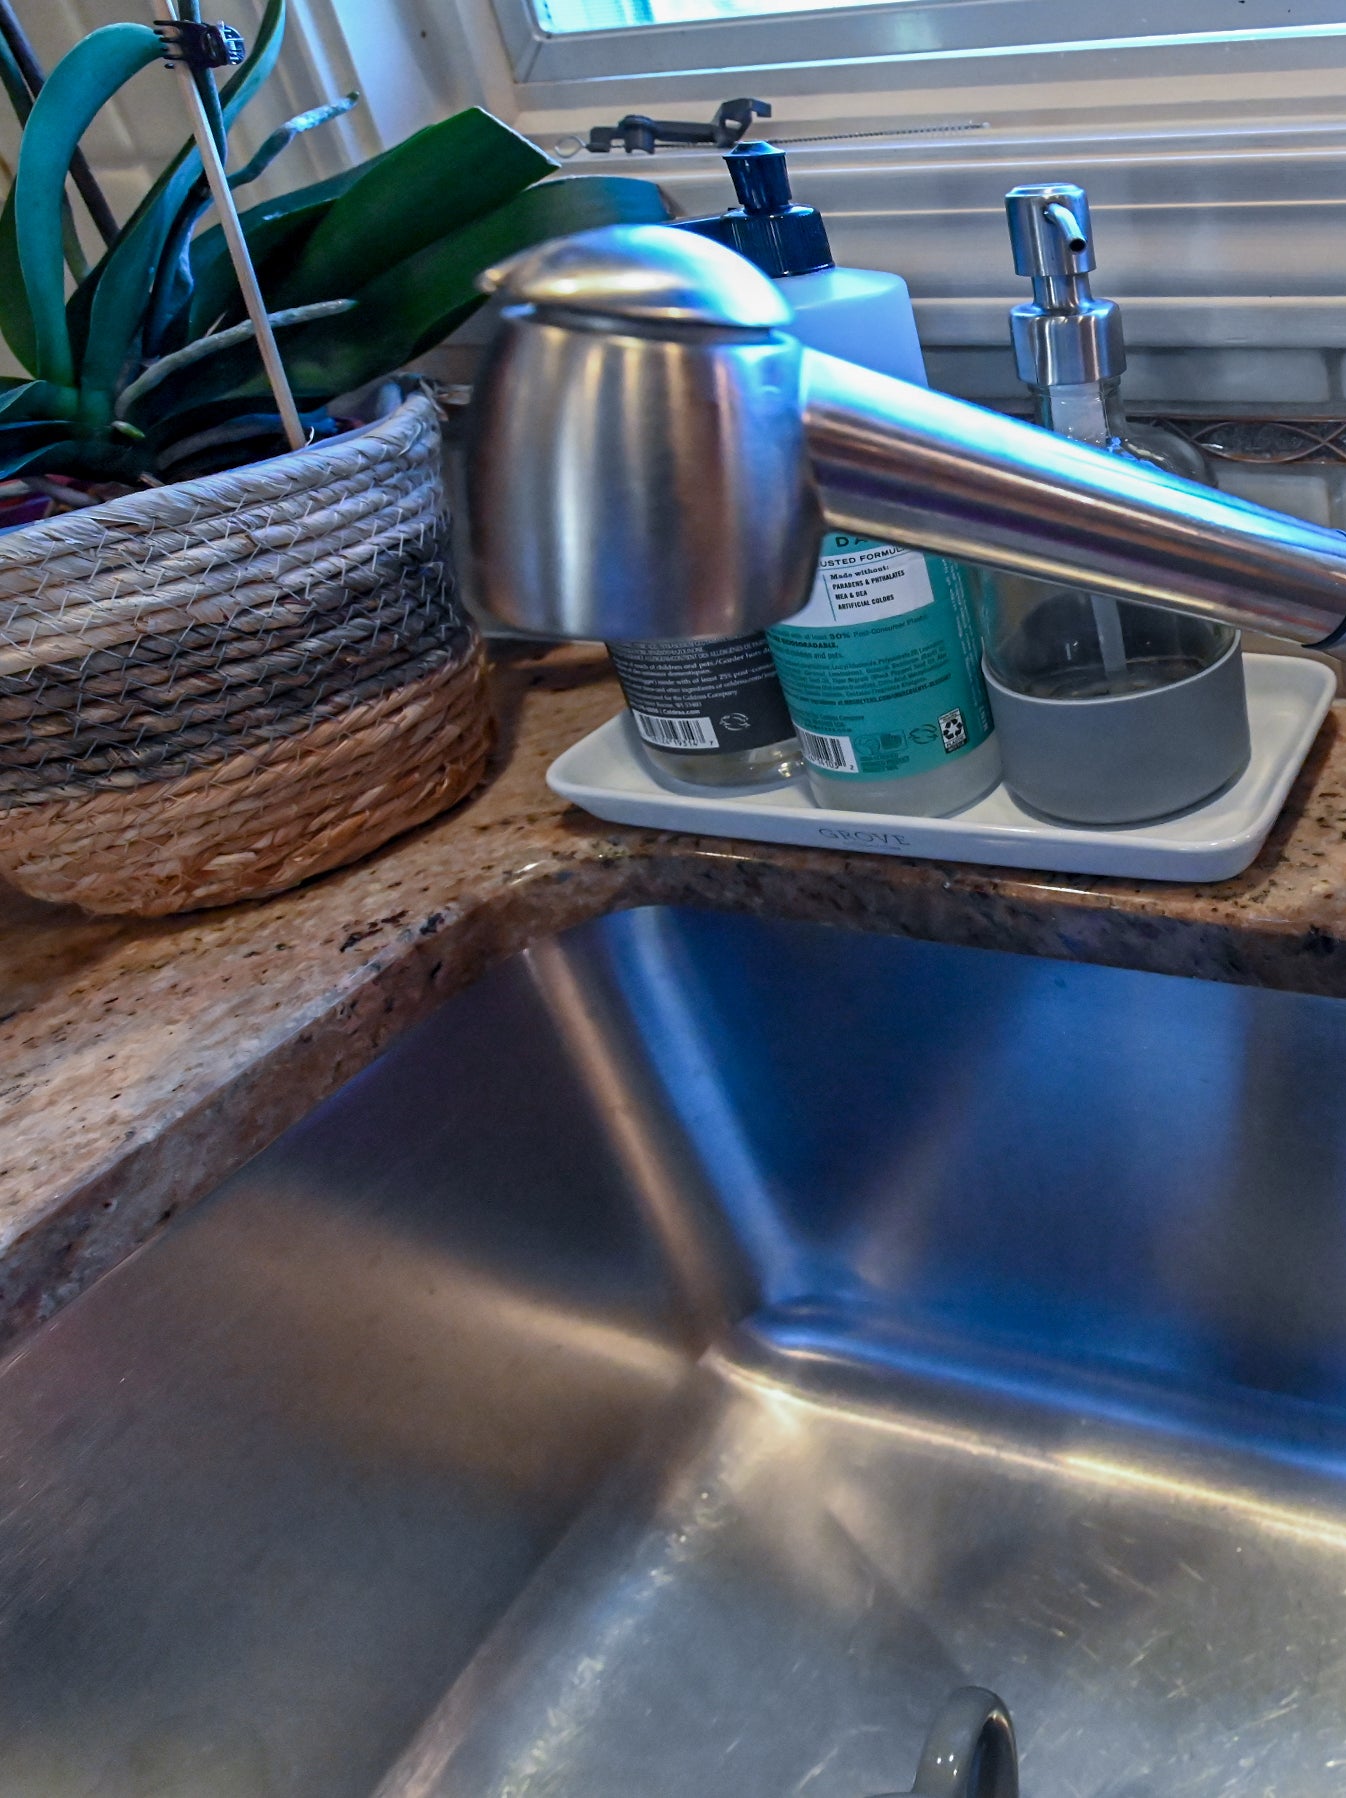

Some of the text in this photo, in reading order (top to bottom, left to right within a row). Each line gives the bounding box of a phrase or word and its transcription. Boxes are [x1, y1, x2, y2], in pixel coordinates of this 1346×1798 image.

[817, 545, 906, 568] USTED FORMUL
[830, 565, 889, 580] Made without:
[832, 580, 864, 590] PARABENS
[871, 570, 905, 584] PHTHALATES
[838, 594, 895, 610] ARTIFICIAL COLORS
[818, 828, 911, 846] GROVE
